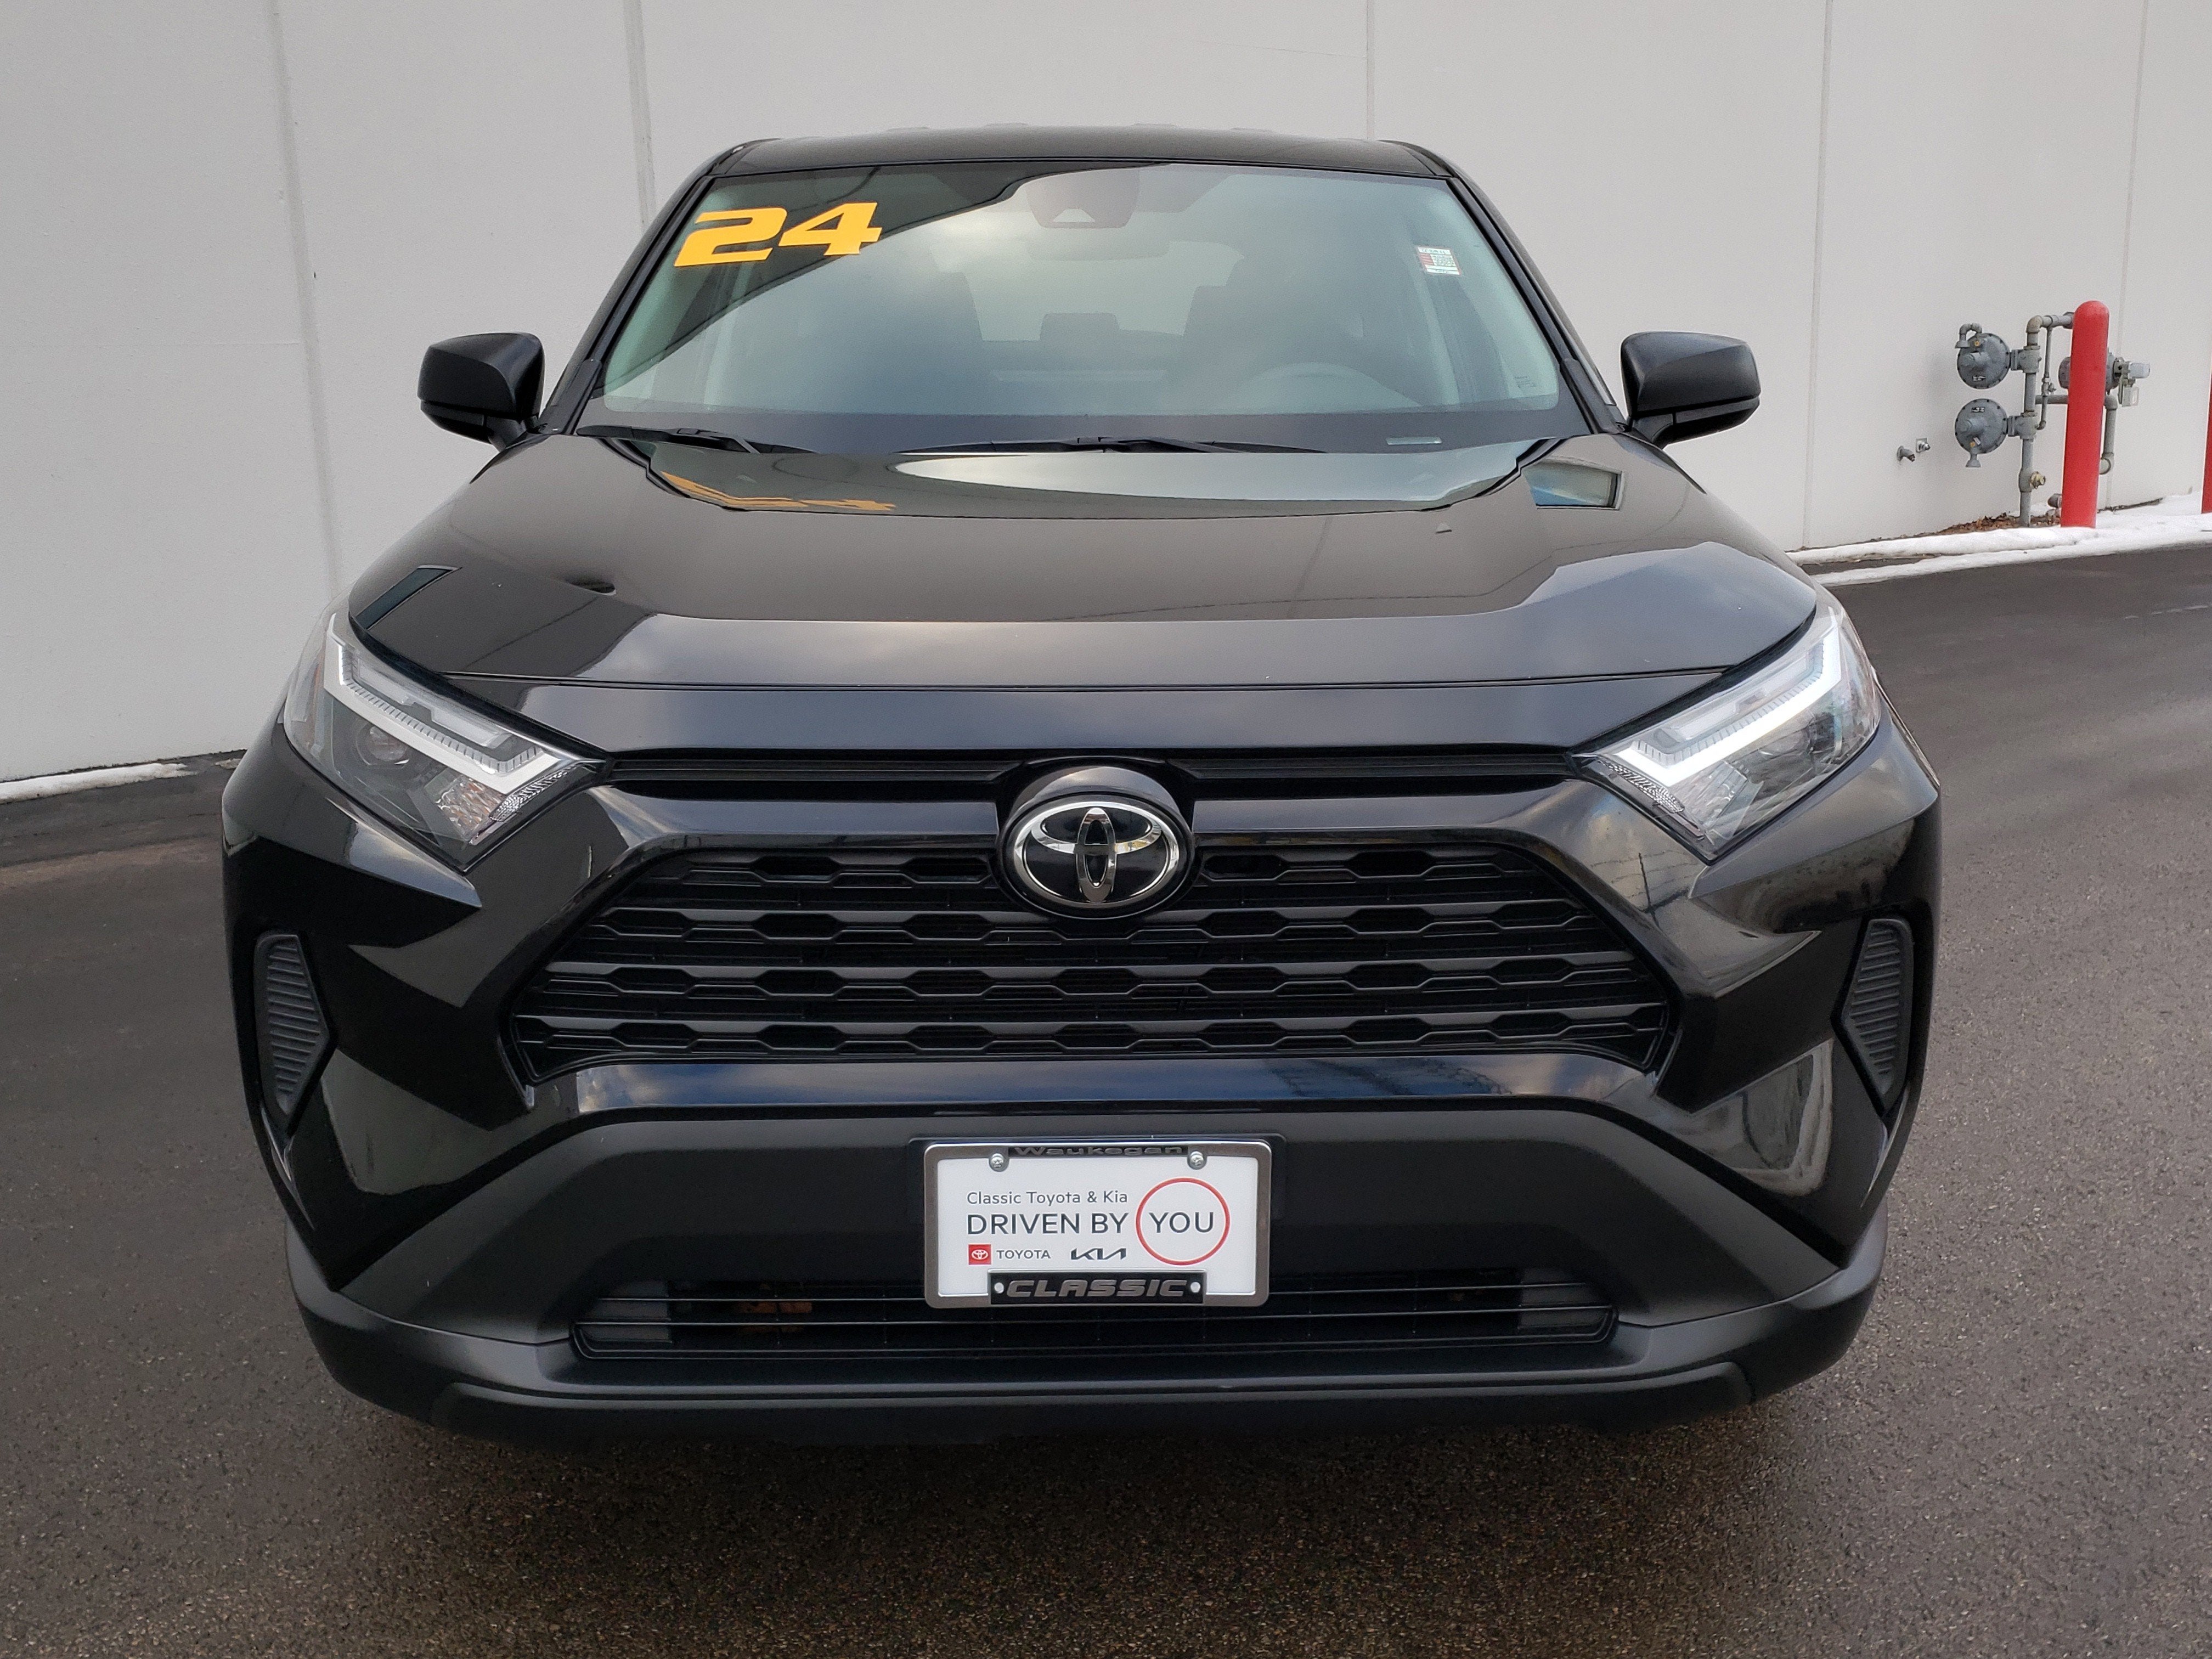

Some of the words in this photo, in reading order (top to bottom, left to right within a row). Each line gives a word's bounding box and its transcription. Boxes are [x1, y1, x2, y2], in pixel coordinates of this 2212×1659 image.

[674, 201, 882, 267] 24
[967, 1191, 1021, 1204] Classic
[1026, 1192, 1080, 1206] Toyota
[1087, 1191, 1097, 1203] &
[1104, 1190, 1127, 1203] Kia
[967, 1214, 1080, 1234] DRIVEN
[1092, 1213, 1128, 1233] BY
[1149, 1212, 1214, 1233] YOU
[996, 1250, 1051, 1259] TOYOTA
[1006, 1279, 1187, 1297] CLASSIC
